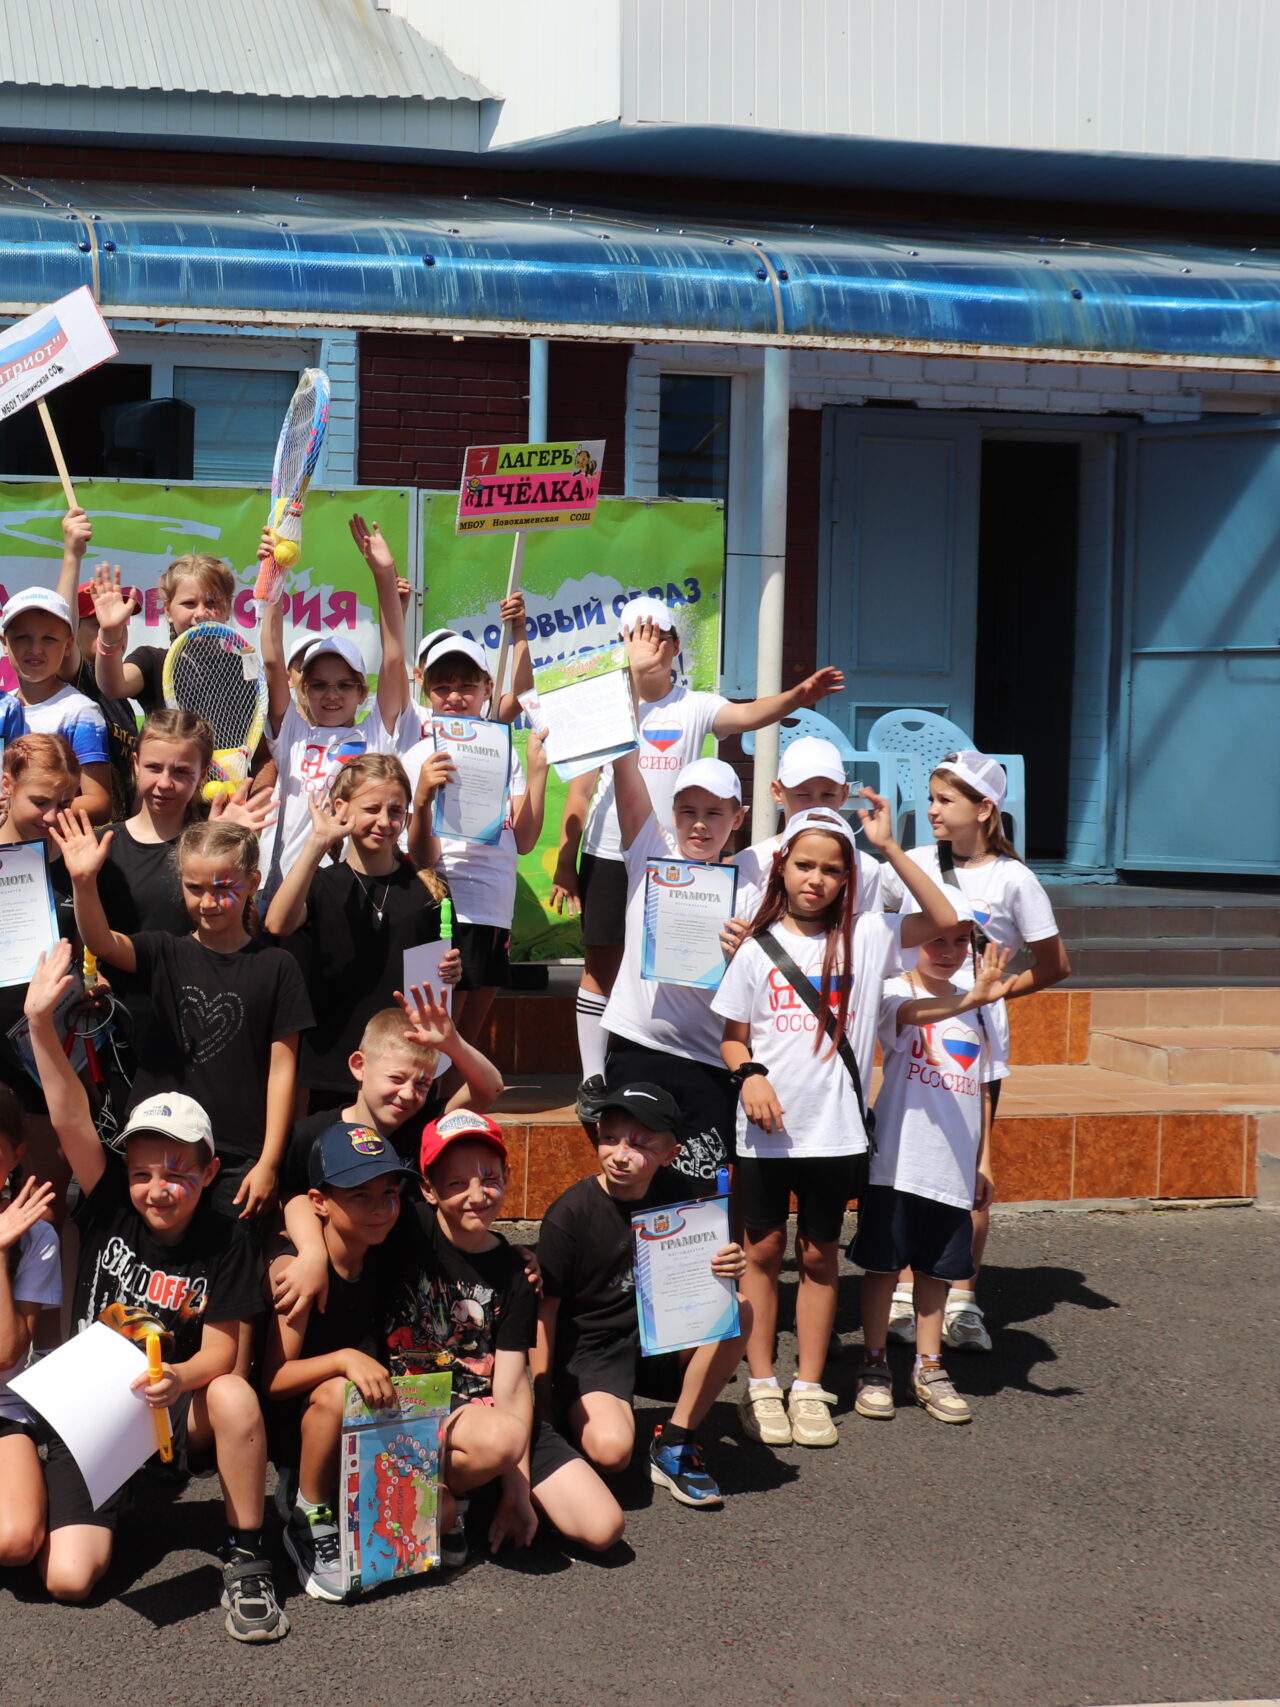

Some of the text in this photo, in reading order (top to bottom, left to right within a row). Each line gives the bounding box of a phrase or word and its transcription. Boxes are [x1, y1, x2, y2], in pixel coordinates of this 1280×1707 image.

[1, 397, 17, 416] МБОУ
[499, 449, 573, 469] ЛАГЕРЬ
[465, 476, 594, 508] «ПЧЁЛКА»
[459, 513, 591, 531] МБОУ Новокаменская СОШ
[456, 743, 501, 759] ГРАМОТА
[668, 889, 722, 903] ГРАМОТА
[660, 1230, 718, 1251] ГРАМОТА
[188, 1276, 208, 1314] 2
